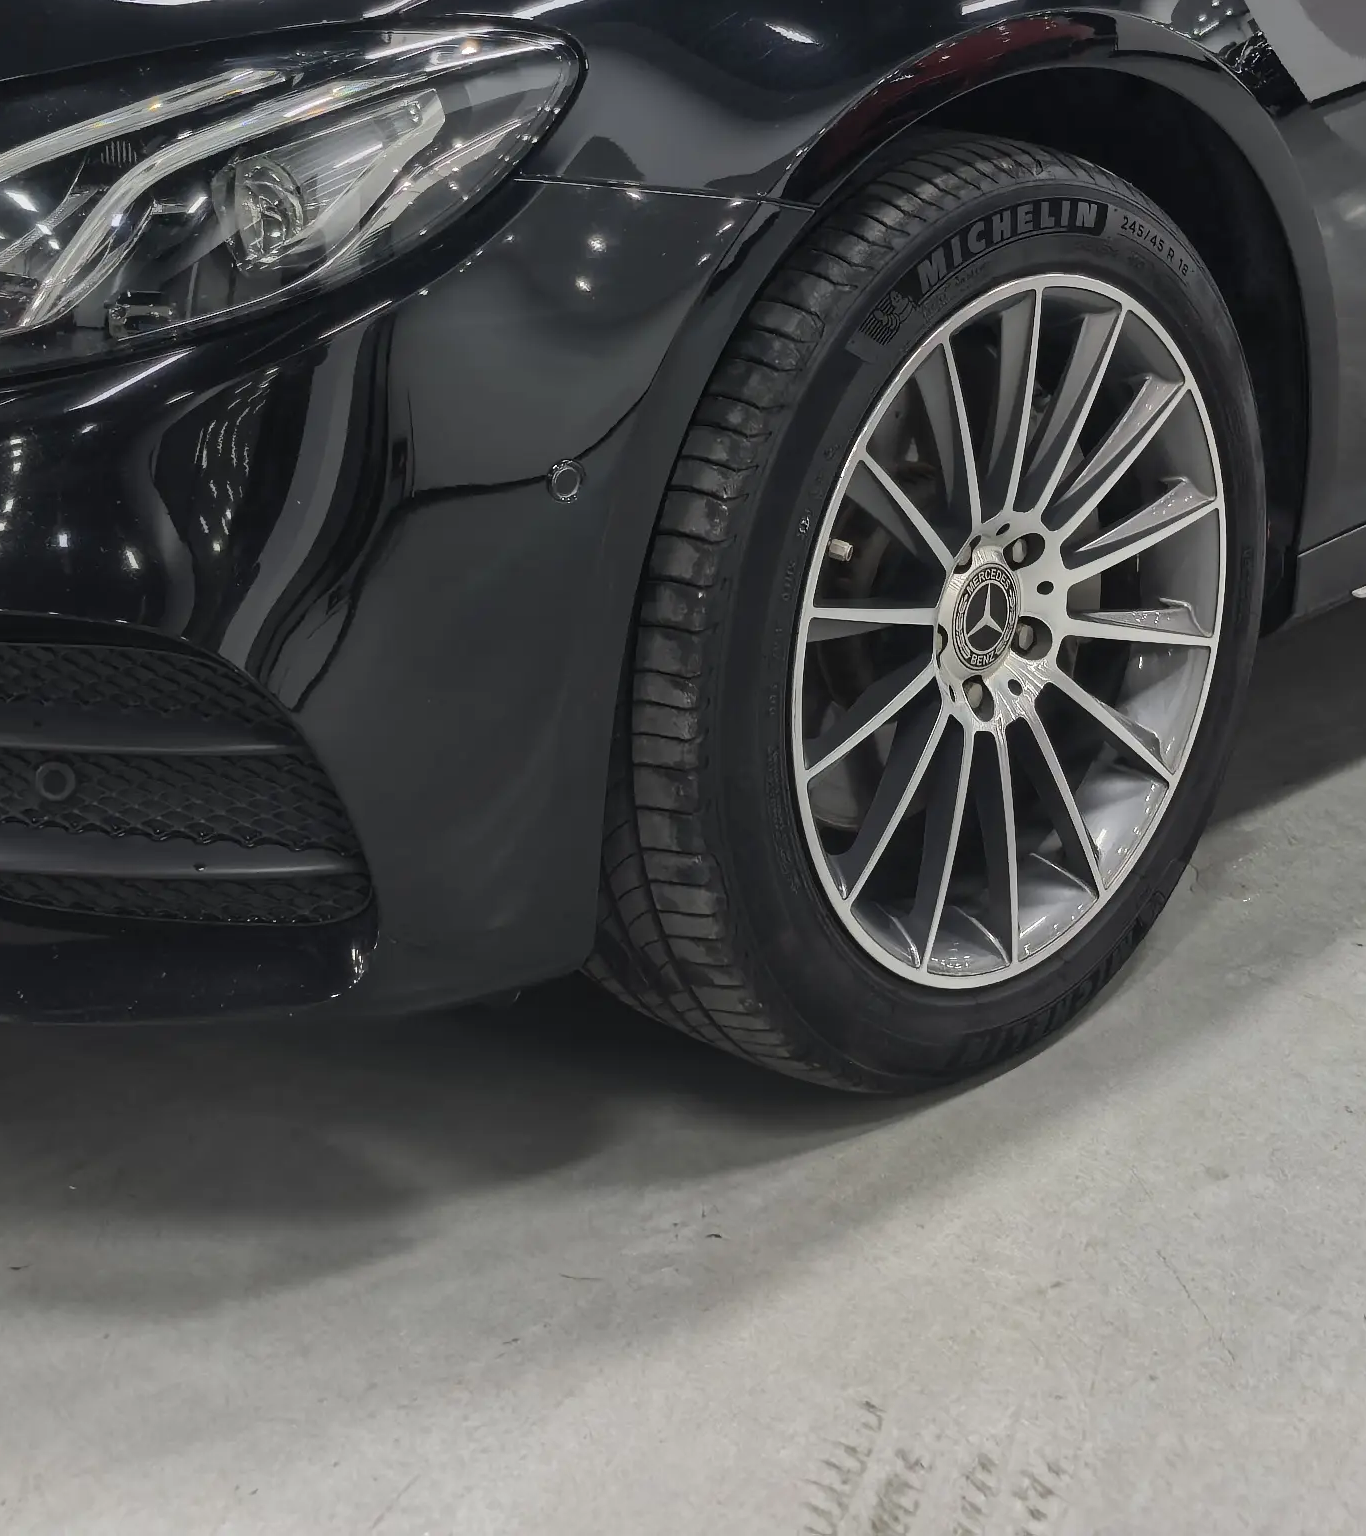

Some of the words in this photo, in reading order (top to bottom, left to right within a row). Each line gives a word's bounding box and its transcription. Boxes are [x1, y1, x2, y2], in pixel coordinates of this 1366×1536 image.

[917, 200, 1098, 294] MICHELIN
[1120, 215, 1165, 252] 245/45
[1166, 246, 1175, 263] R
[1178, 258, 1189, 276] 18
[966, 568, 1011, 595] MERCEDES
[970, 651, 996, 666] BENZ
